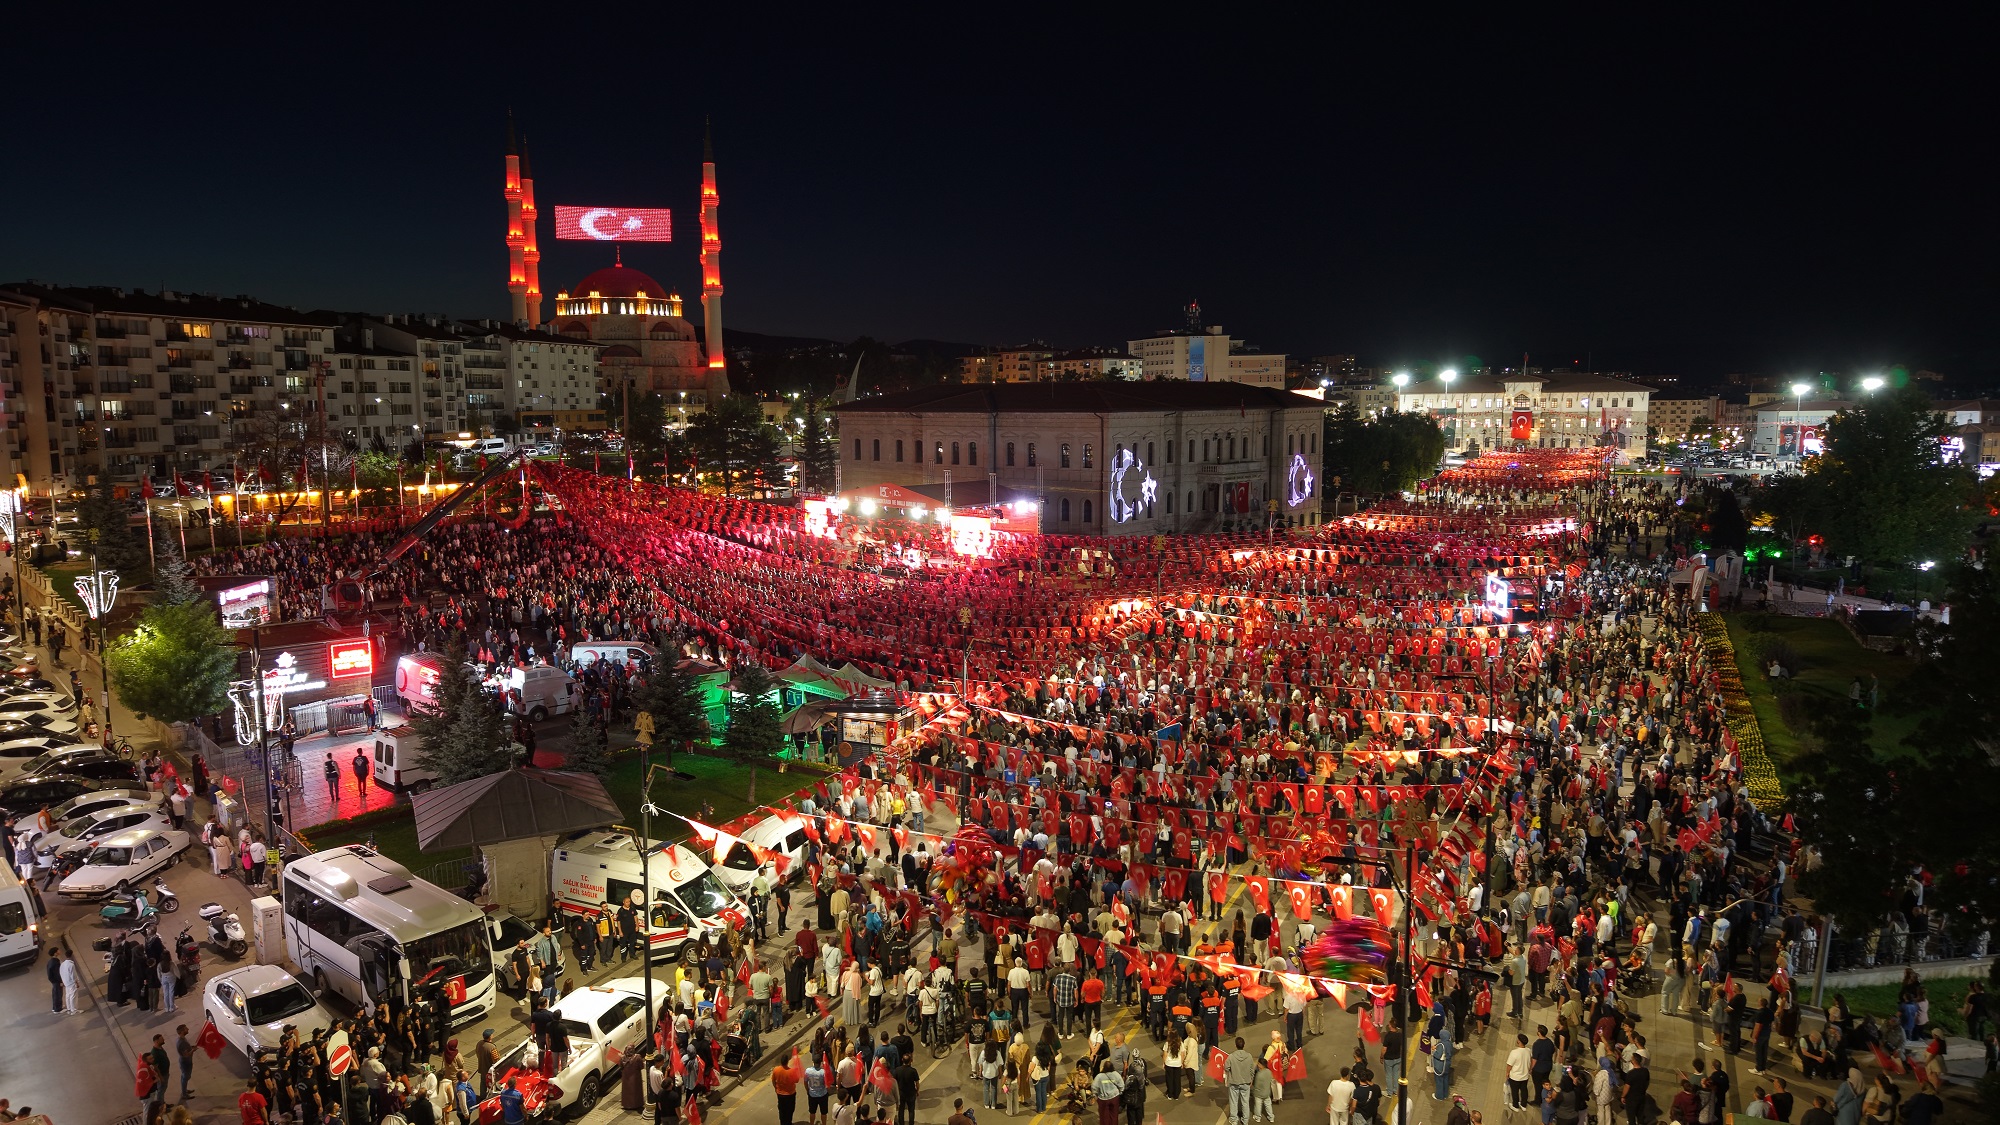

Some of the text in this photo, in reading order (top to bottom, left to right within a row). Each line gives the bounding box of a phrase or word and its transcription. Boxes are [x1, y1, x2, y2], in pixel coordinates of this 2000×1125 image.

[563, 879, 605, 893] SAĞLIK BAKANLIĞI
[581, 890, 598, 898] SAĞLIK
